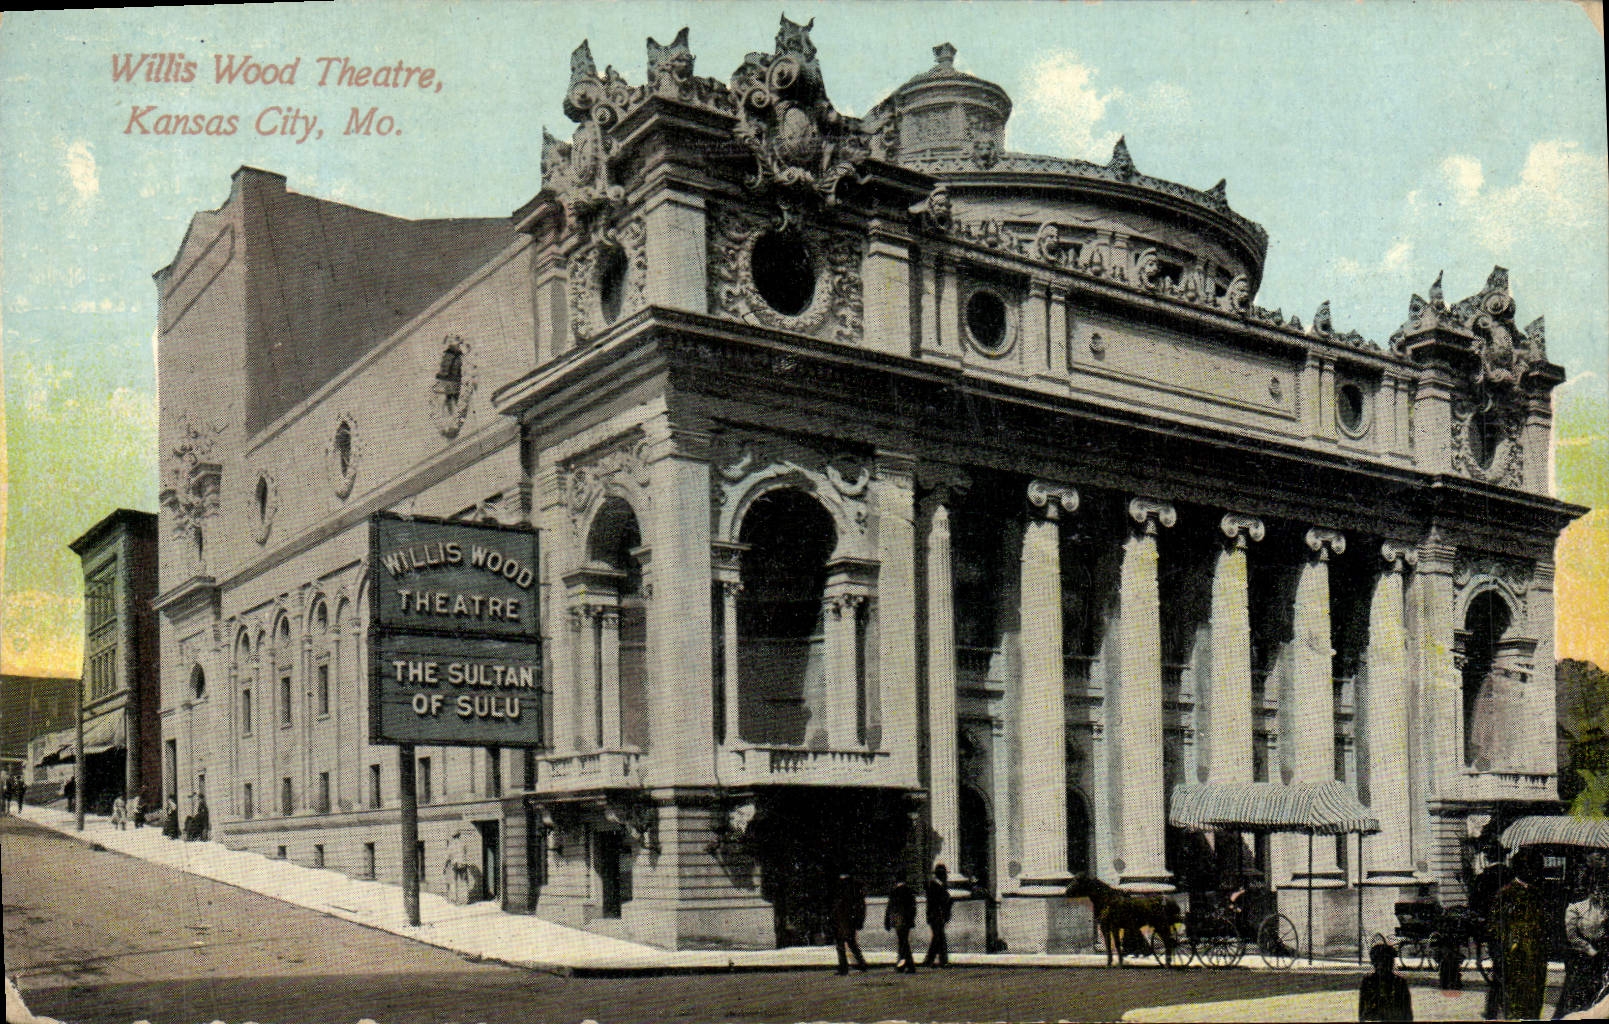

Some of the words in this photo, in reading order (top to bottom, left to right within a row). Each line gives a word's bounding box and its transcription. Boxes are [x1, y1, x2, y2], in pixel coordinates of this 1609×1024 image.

[381, 542, 462, 576] WILLIS
[471, 545, 533, 588] WOOD
[398, 590, 520, 618] THEATRE
[392, 661, 438, 684] THE
[448, 663, 534, 688] SULTAN
[412, 693, 444, 716] OF
[457, 695, 520, 718] SULU
